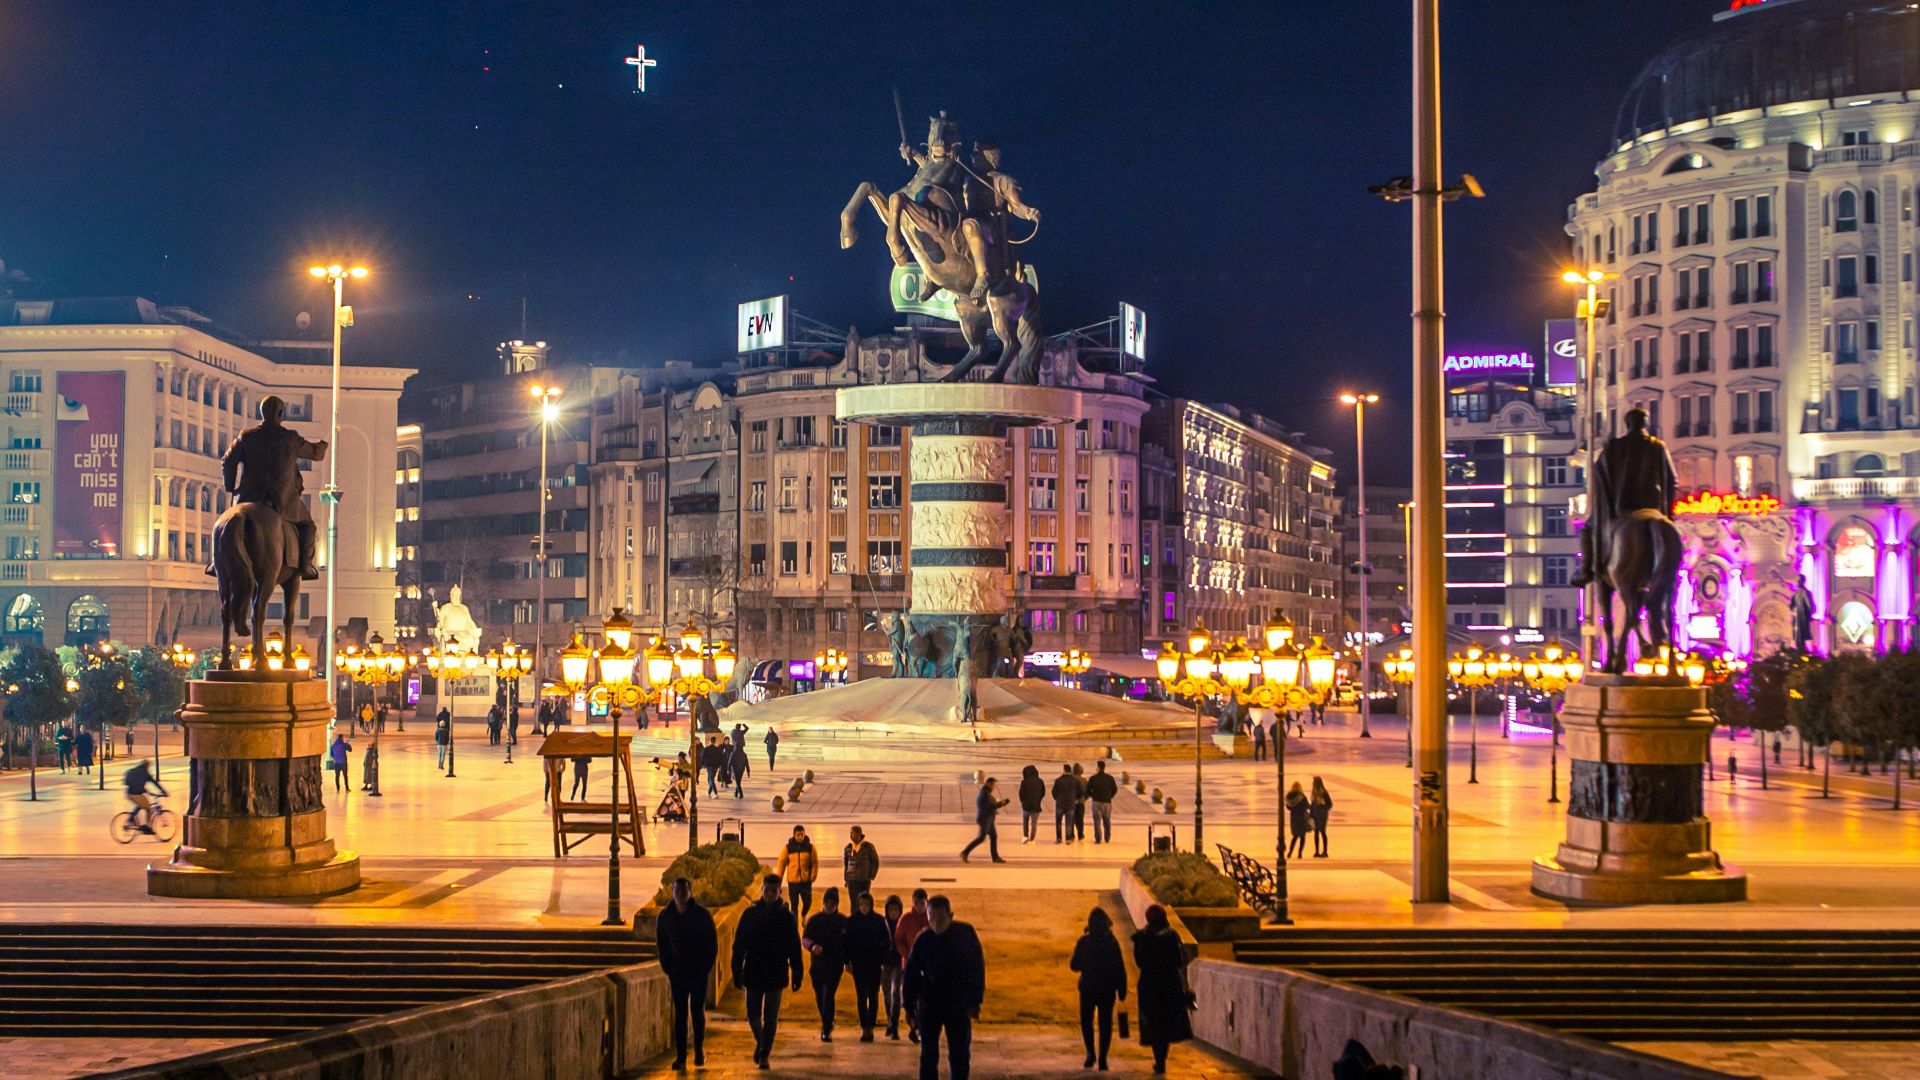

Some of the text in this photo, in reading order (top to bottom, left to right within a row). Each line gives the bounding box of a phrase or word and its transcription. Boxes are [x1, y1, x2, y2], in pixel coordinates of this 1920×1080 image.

[748, 312, 773, 336] EVN
[1443, 352, 1535, 371] ADMIRAL
[90, 433, 118, 453] you
[74, 448, 117, 468] can't
[80, 468, 117, 487] miss
[93, 492, 117, 507] me
